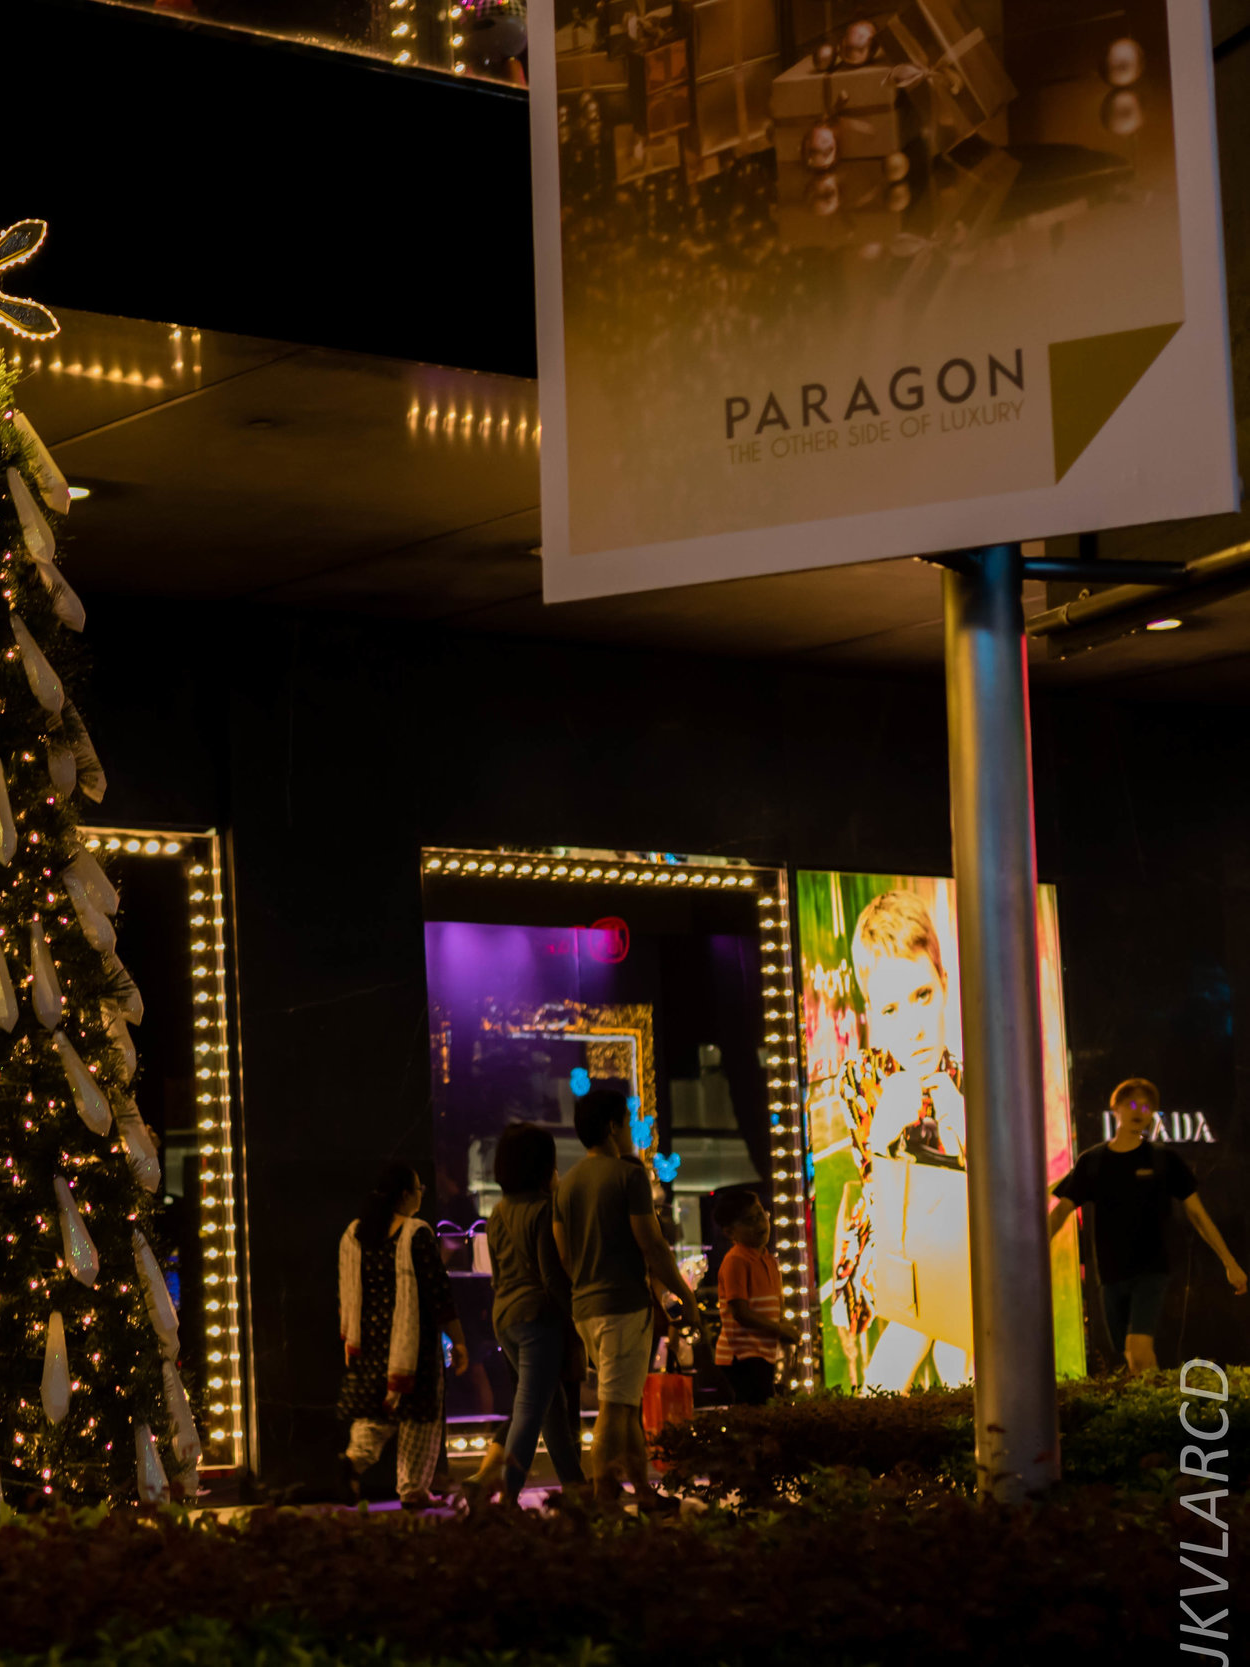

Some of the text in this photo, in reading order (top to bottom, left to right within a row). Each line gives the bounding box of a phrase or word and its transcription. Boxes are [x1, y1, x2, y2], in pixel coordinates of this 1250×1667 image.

[725, 348, 1025, 439] PARAGON
[727, 400, 1025, 465] THE OTHER SIDE OF LUXURY
[1102, 1110, 1217, 1143] ADA
